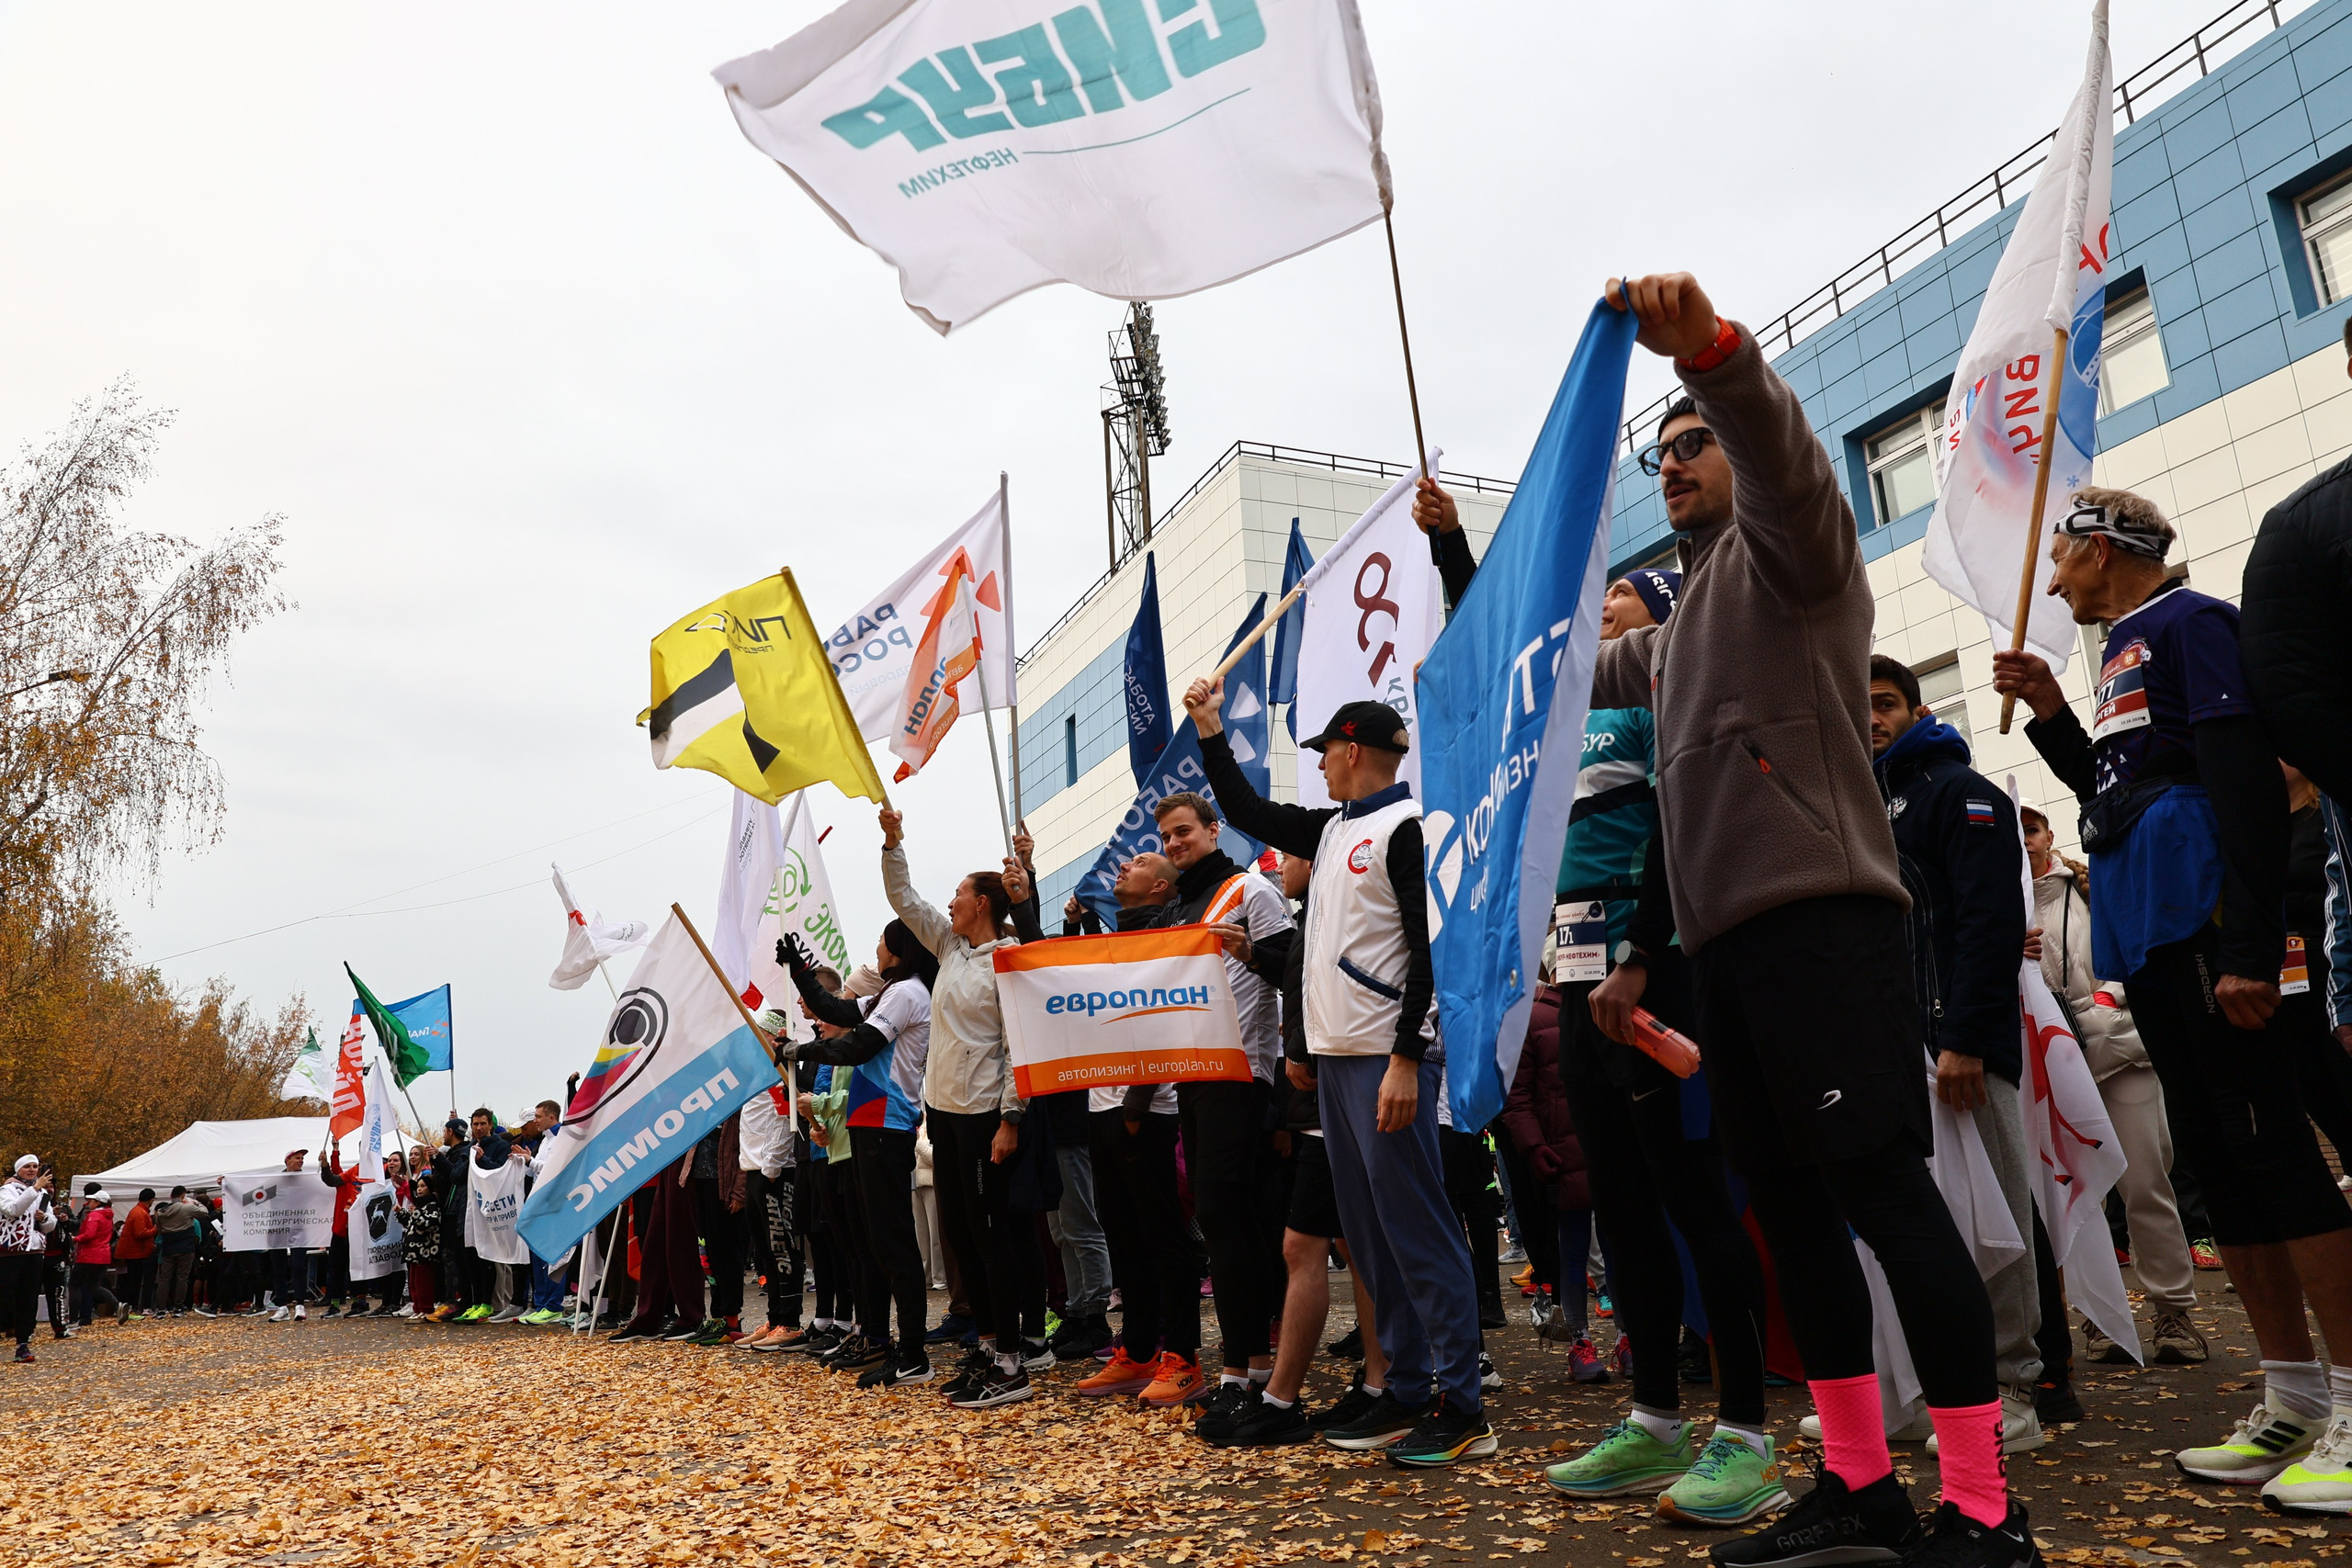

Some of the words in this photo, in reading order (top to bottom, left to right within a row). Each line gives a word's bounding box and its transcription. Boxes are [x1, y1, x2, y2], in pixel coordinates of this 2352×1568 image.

[1580, 732, 1615, 754] БУР
[2195, 953, 2216, 1014] NORDSKI
[1046, 985, 1208, 1017] европлан
[1057, 1064, 1136, 1082] автолизинг
[1148, 1058, 1224, 1075] europlan.ru
[242, 1209, 316, 1219] ОБЪЕДИНЕННАЯ
[243, 1217, 334, 1227] МЕТАЛЛУРГИЧЕСКАЯ
[243, 1227, 290, 1235] КОМПАНИЯ
[1176, 1374, 1194, 1391] HOKA
